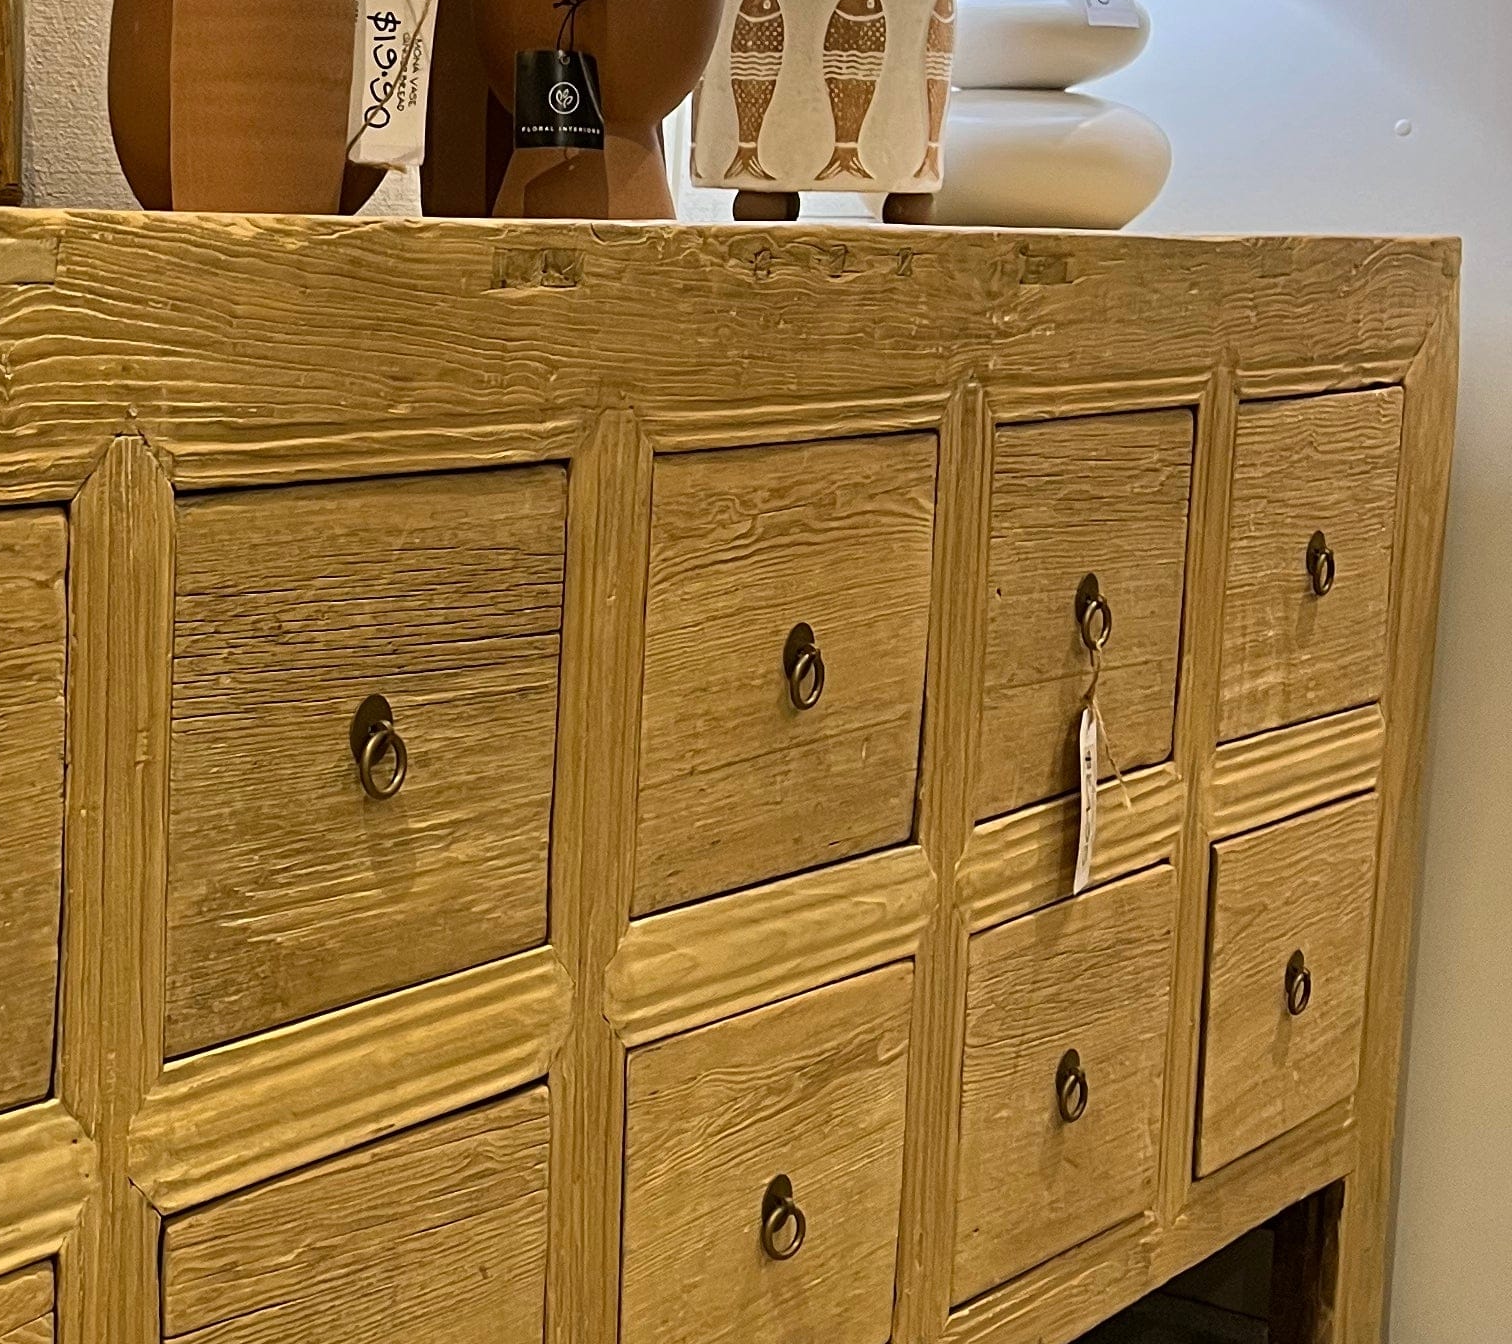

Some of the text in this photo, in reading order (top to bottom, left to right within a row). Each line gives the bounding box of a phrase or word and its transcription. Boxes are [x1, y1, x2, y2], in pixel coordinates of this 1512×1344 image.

[364, 11, 401, 128] $19.90
[408, 39, 423, 106] MONA VASE
